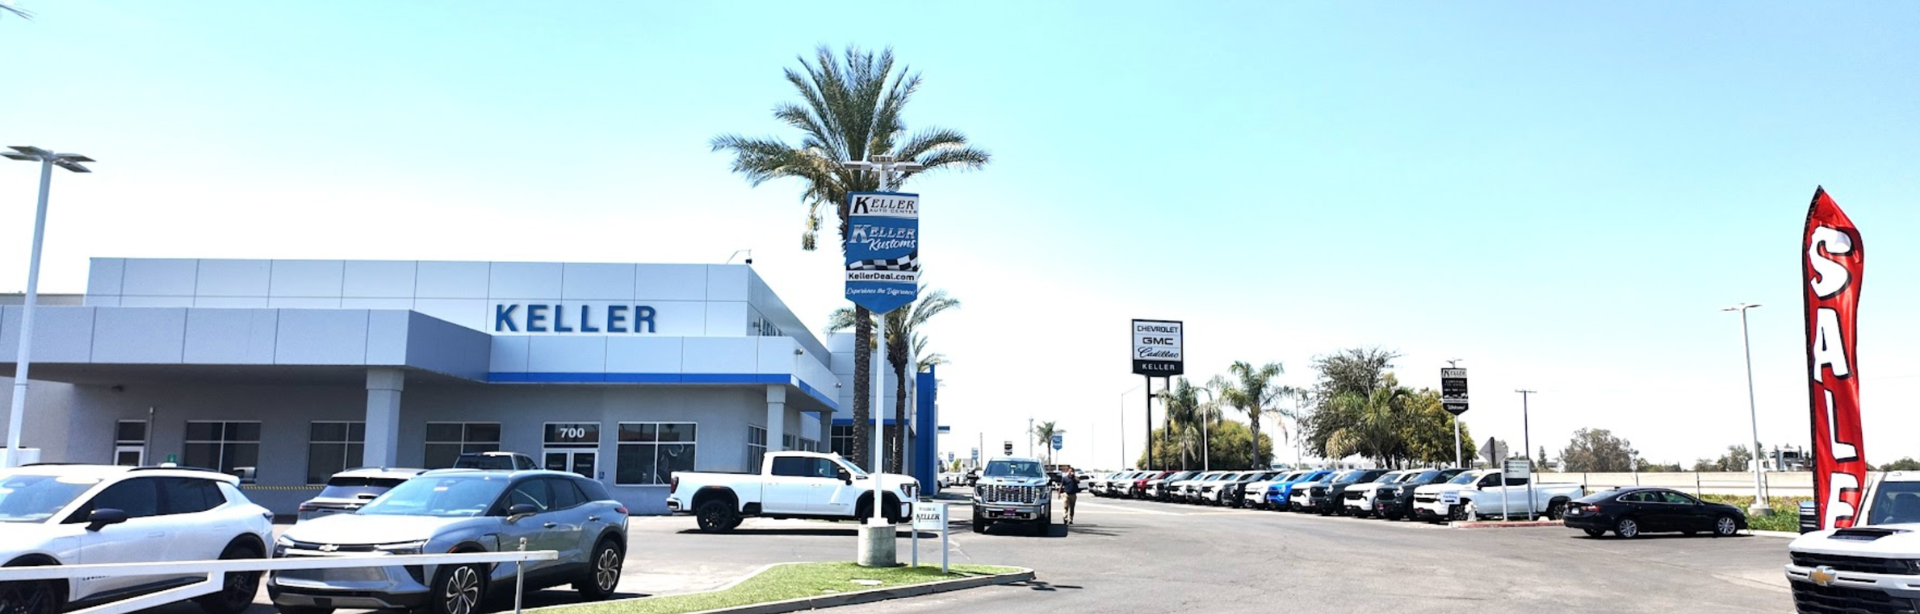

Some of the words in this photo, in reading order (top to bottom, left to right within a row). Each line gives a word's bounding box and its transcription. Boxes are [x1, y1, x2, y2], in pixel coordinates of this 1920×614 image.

[852, 196, 915, 214] KELLER
[849, 224, 916, 243] KELLER
[868, 239, 916, 251] Kustoms
[848, 272, 915, 281] KellerDeal.com
[495, 304, 656, 333] KELLER
[1137, 325, 1178, 333] CHEVROLET
[1143, 337, 1173, 345] GMC
[1137, 346, 1179, 358] Cadillac
[1809, 226, 1859, 530] SALE
[560, 427, 585, 438] 700
[916, 513, 940, 523] KELLER
